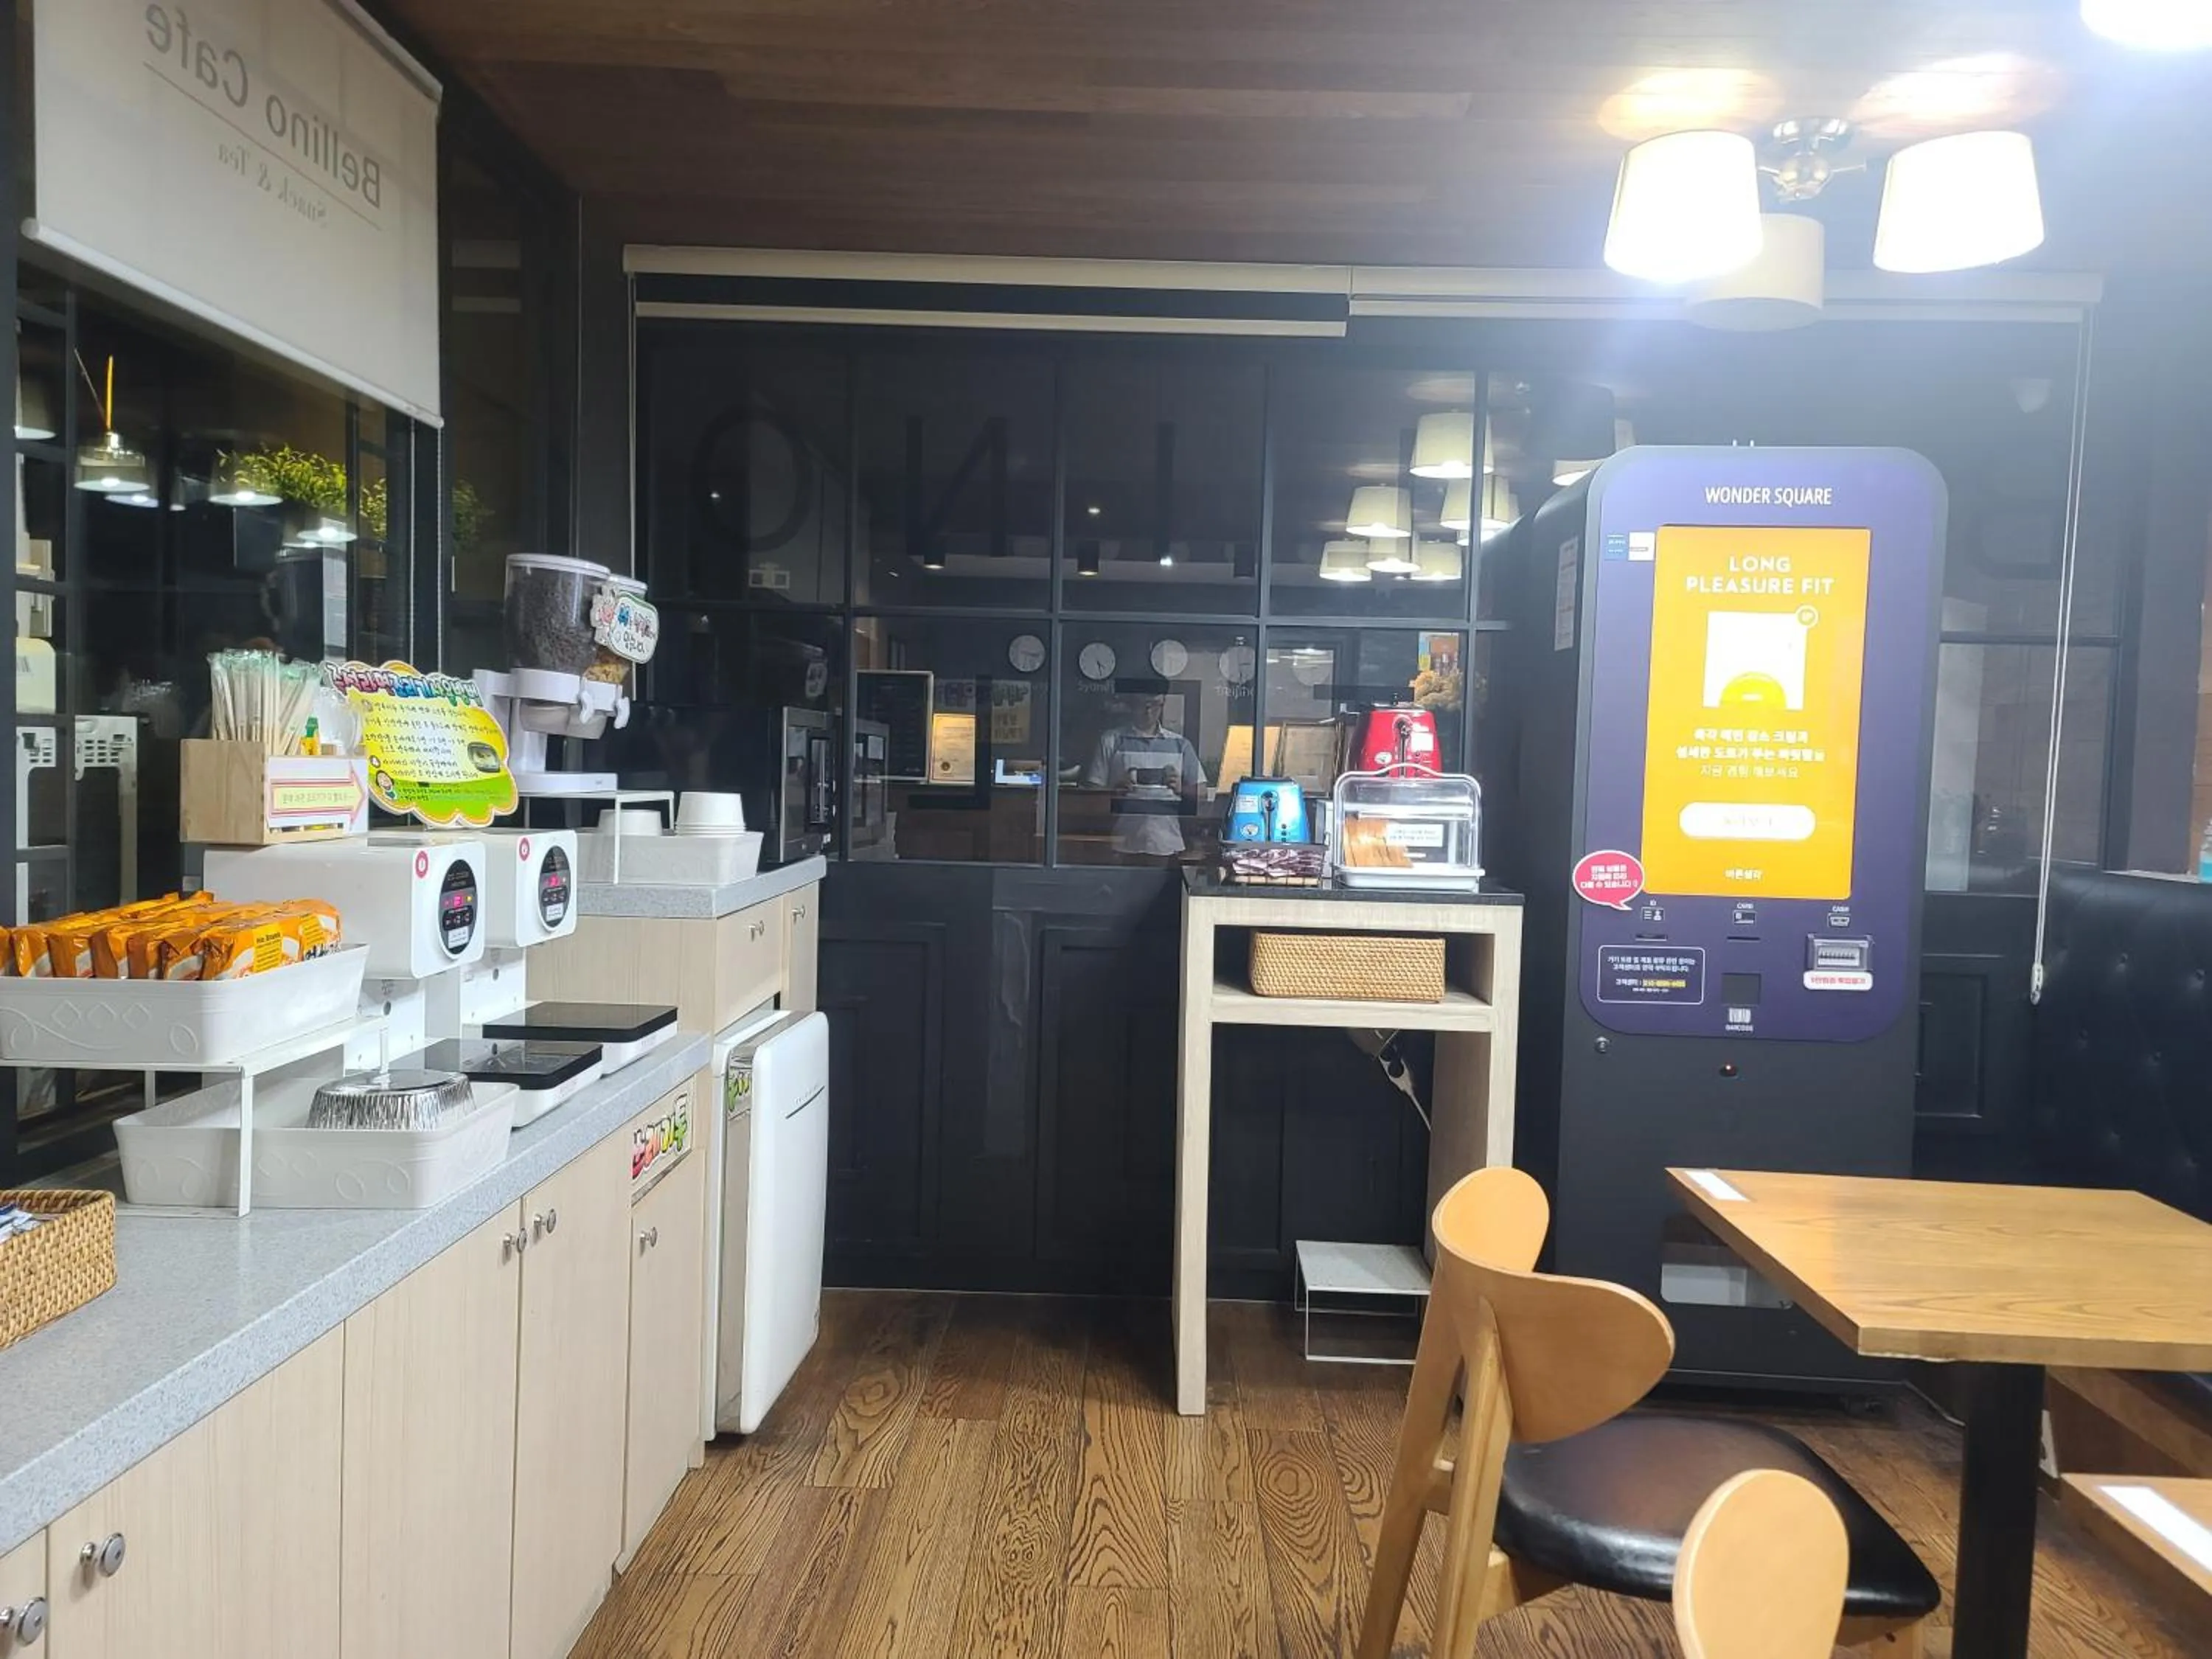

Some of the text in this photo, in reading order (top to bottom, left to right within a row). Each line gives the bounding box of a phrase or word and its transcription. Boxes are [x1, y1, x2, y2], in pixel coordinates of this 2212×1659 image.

[1705, 487, 1832, 507] WONDER SQUARE
[1728, 555, 1791, 573] LONG
[1686, 576, 1834, 595] PLEASURE FIT
